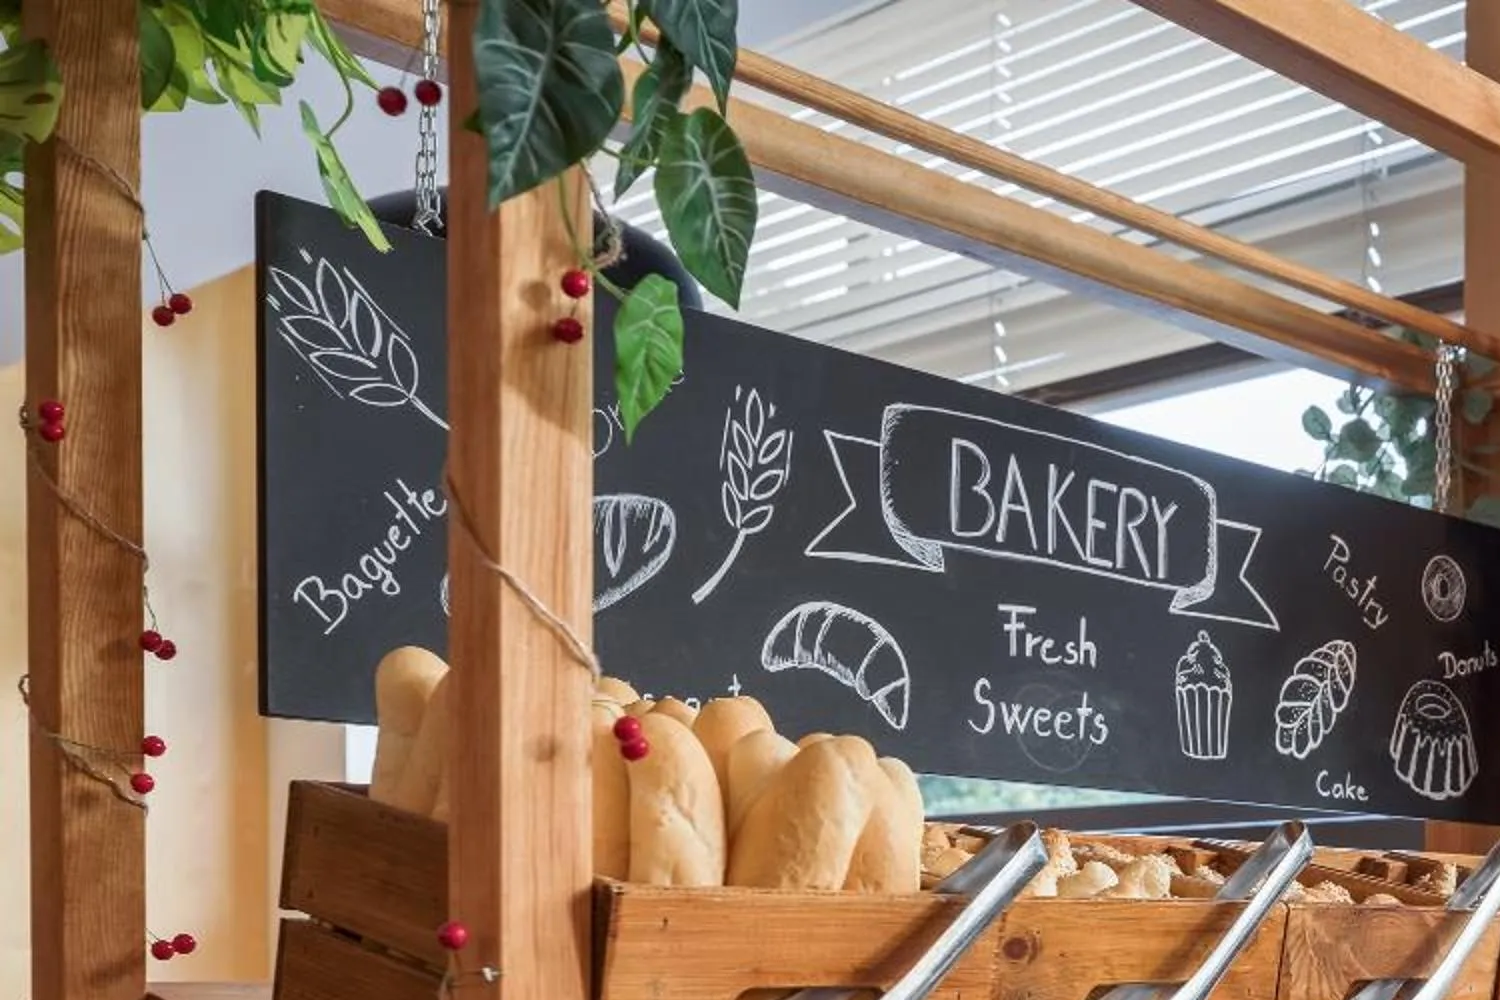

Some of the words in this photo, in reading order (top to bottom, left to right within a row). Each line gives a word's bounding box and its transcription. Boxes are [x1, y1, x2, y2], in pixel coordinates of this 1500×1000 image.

[950, 437, 1178, 580] BAKERY
[292, 478, 448, 636] Baguette
[1323, 533, 1389, 630] Pastry
[998, 603, 1097, 668] Fresh
[1438, 647, 1499, 680] Donuts
[968, 677, 1109, 746] Sweets
[1315, 770, 1369, 801] Cake
